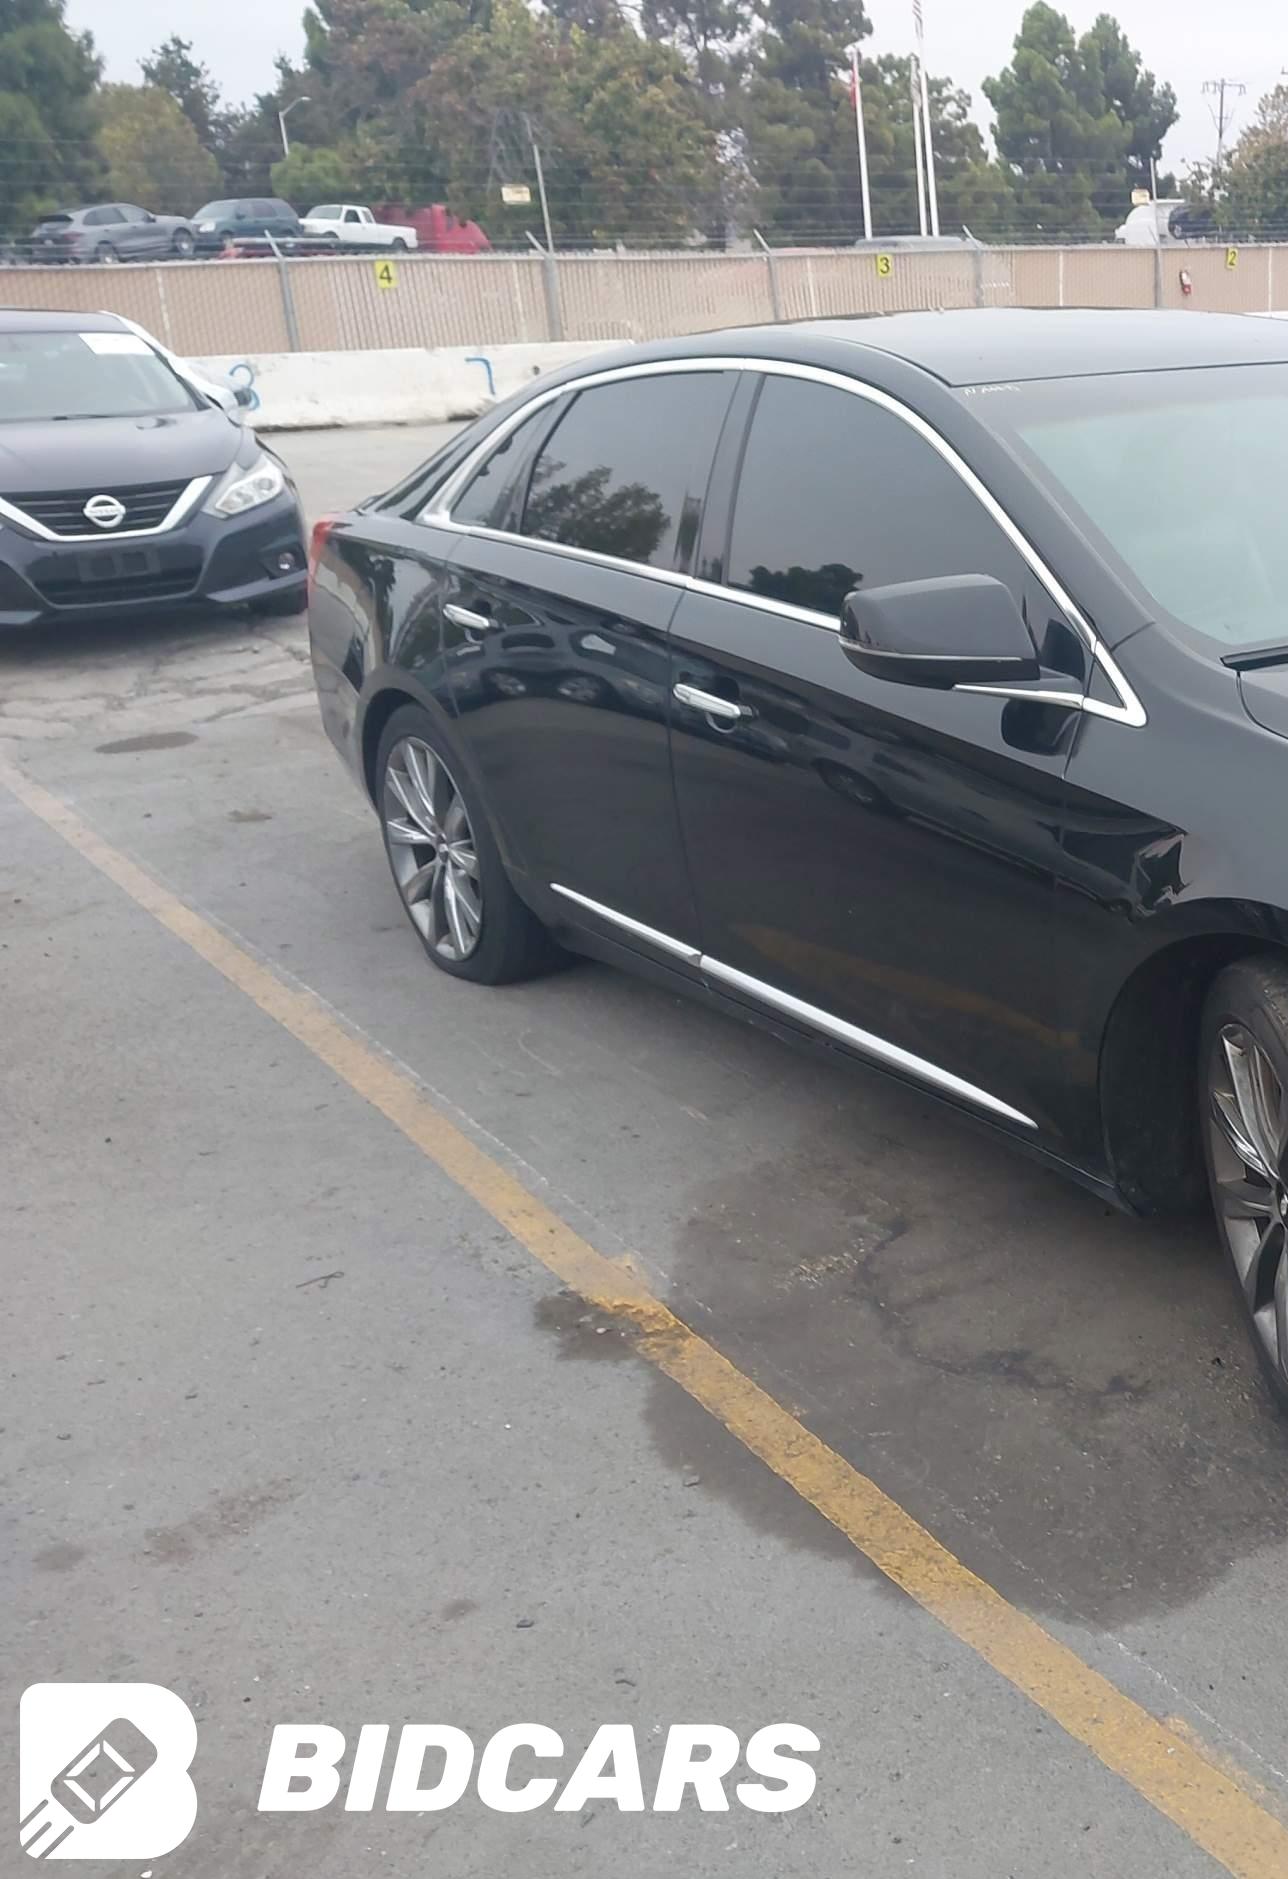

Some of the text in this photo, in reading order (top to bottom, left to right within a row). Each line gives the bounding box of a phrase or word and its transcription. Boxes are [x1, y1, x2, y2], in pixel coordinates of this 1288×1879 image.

[879, 256, 891, 275] 3
[1228, 249, 1238, 267] 2
[379, 263, 393, 285] 4
[464, 356, 497, 396] 7
